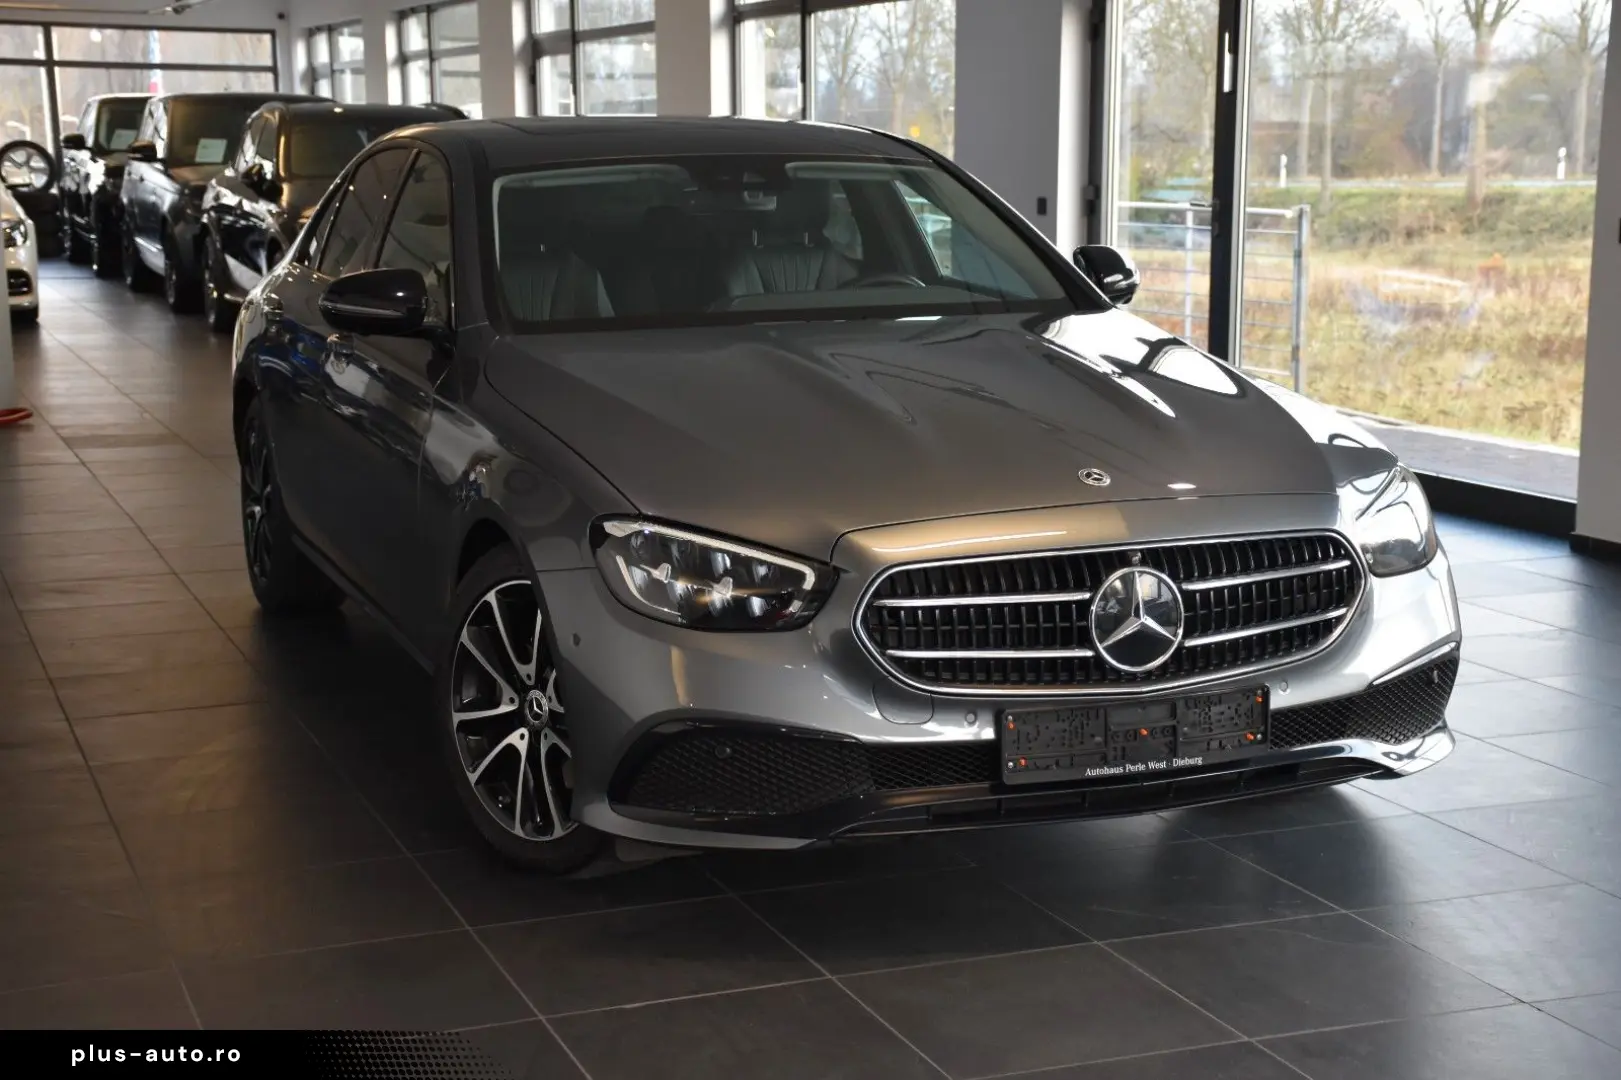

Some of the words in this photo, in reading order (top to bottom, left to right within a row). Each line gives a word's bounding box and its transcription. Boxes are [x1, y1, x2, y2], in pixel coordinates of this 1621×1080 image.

[1084, 765, 1124, 777] Autohaus
[1125, 762, 1146, 773] Perle
[1147, 760, 1167, 770] West
[1172, 756, 1204, 768] Dieburg
